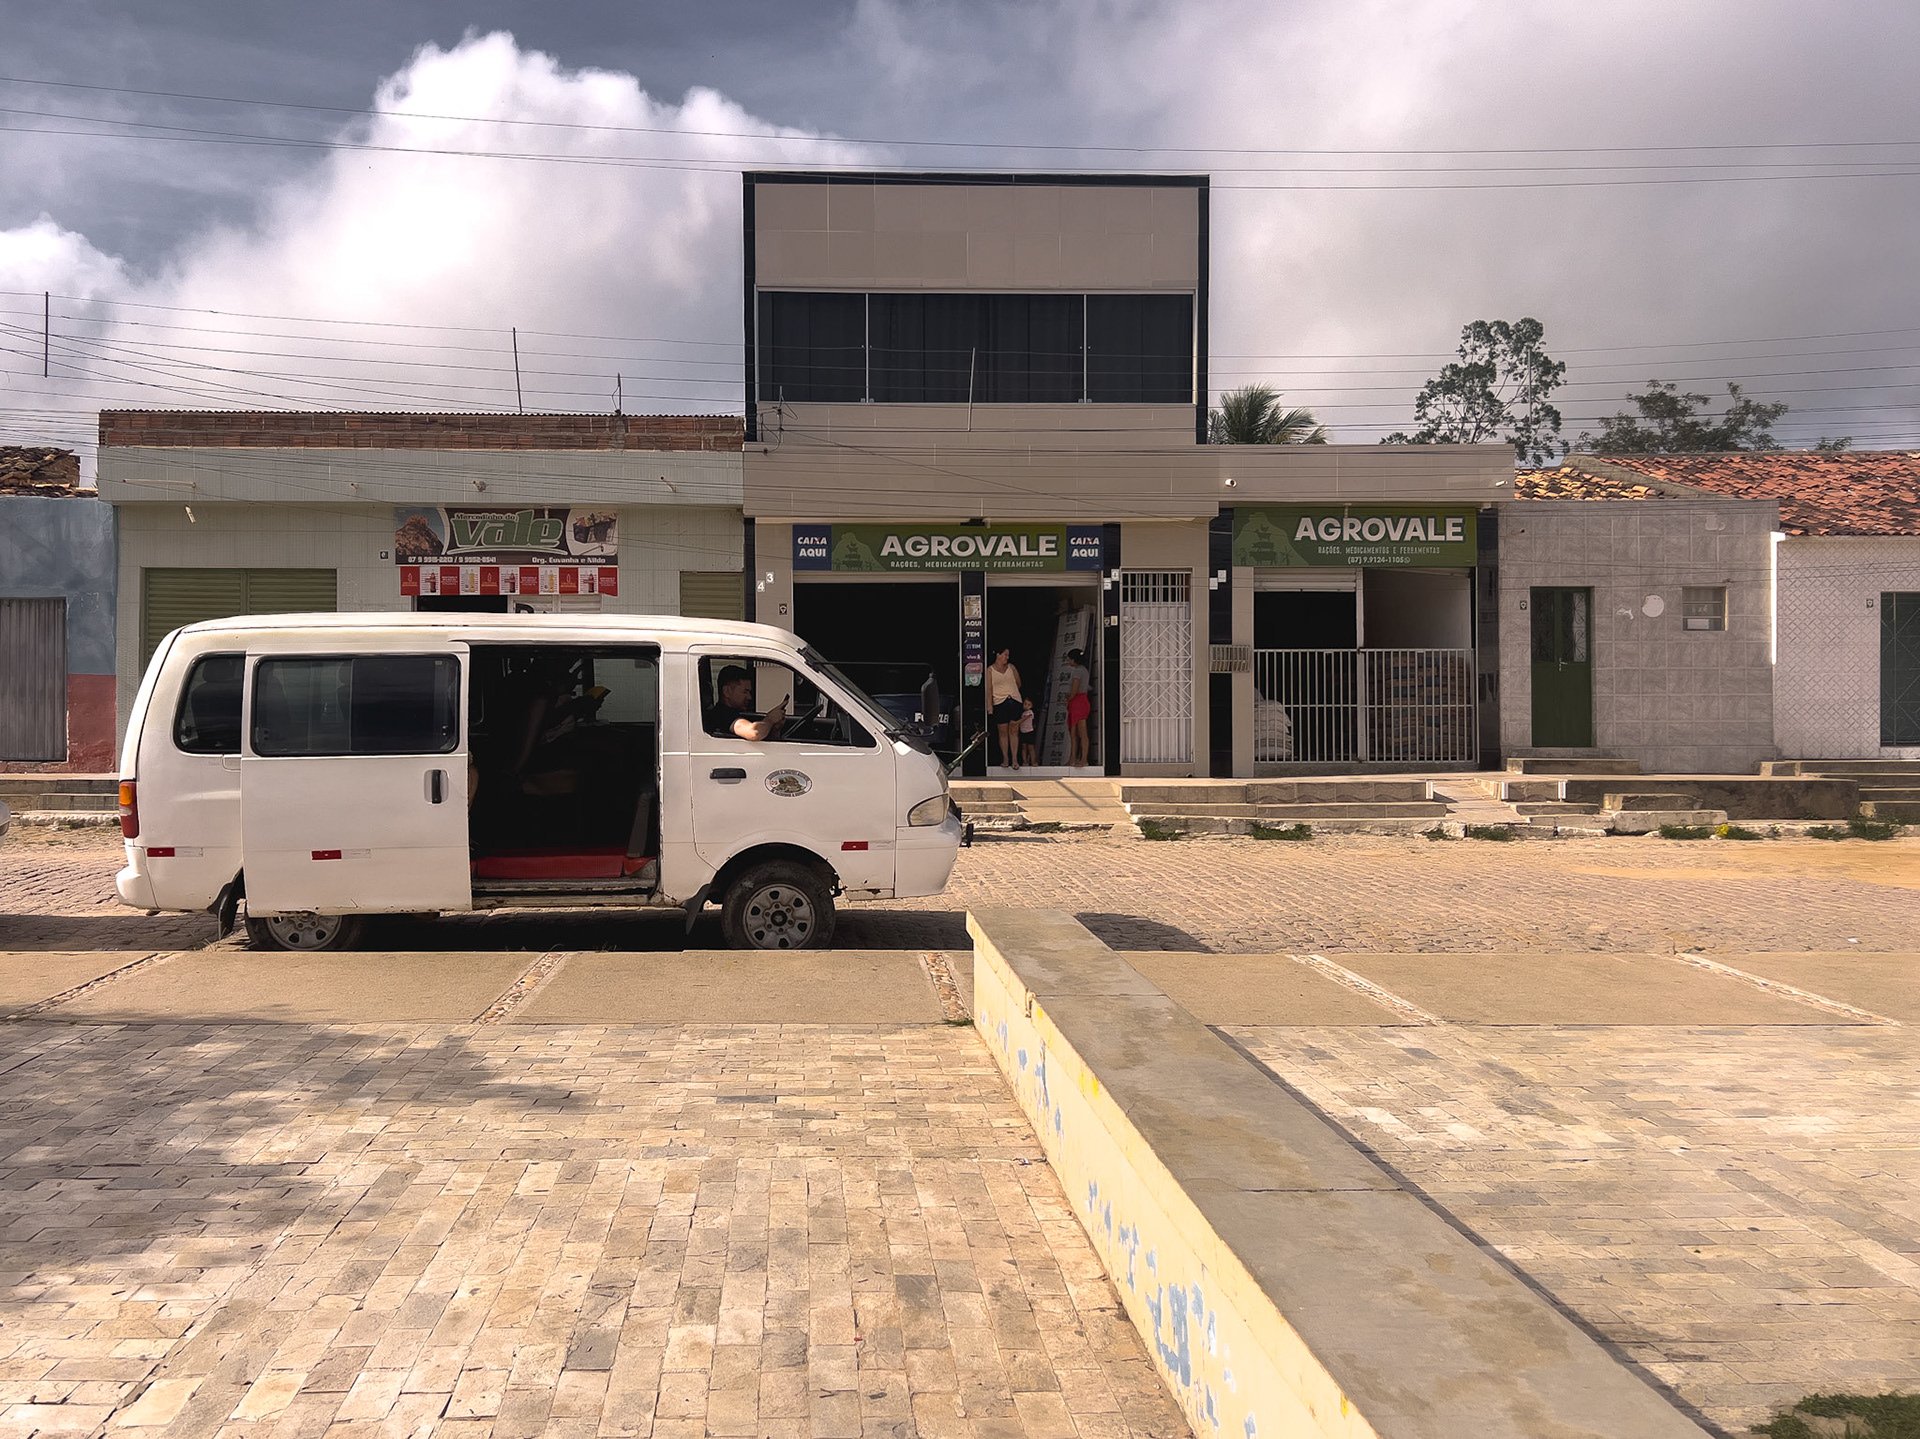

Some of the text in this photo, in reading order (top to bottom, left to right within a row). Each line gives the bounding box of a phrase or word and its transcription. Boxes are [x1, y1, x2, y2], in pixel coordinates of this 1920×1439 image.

[505, 513, 516, 521] do
[1293, 517, 1464, 542] AGROVALE
[797, 536, 827, 545] CAIXA
[1070, 537, 1100, 545] CAIXA
[880, 535, 1058, 557] AGROVALE
[1346, 546, 1390, 555] MEDICAMENTOS
[1400, 546, 1440, 555] FERRAMENTAS
[798, 548, 827, 557] AQUI
[1071, 548, 1099, 557] AQUI
[891, 560, 921, 569] RAÇÕES,
